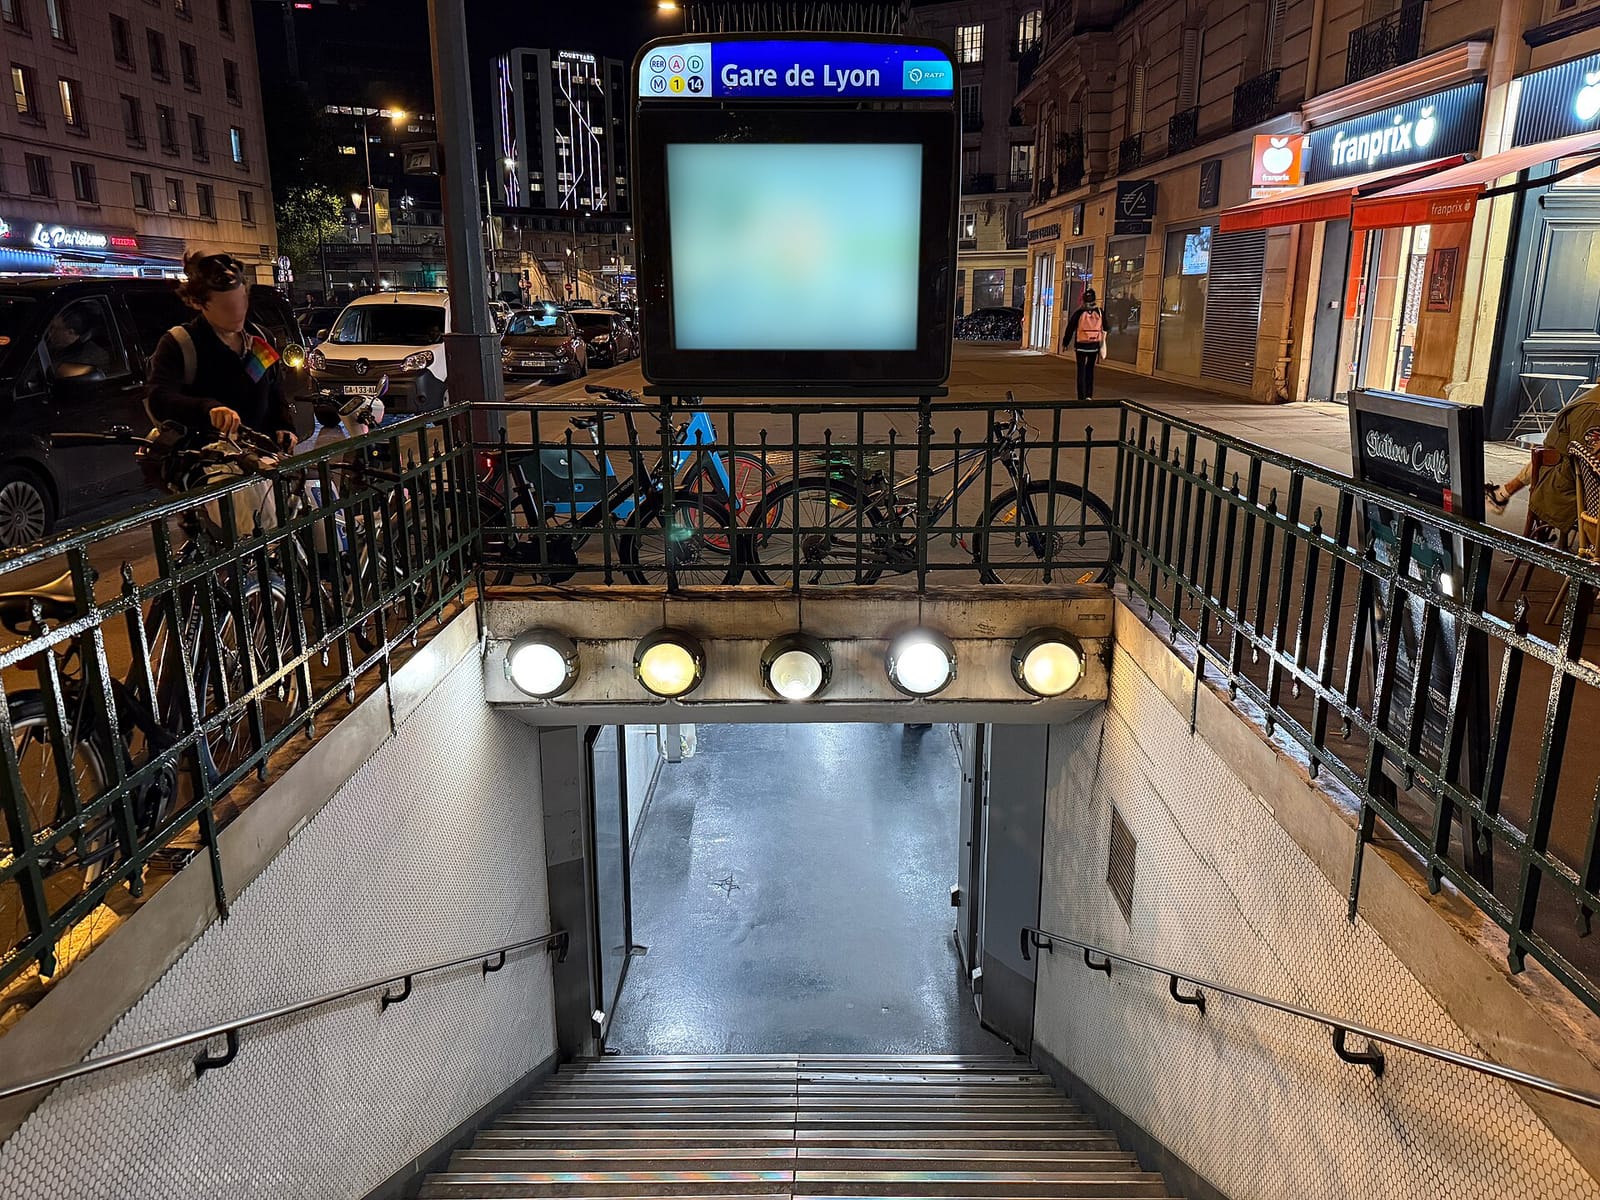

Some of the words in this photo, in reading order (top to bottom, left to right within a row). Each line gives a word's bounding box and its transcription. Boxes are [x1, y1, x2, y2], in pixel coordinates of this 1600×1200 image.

[559, 51, 595, 61] COURTYARD
[651, 60, 665, 68] RER
[673, 60, 681, 69] A
[692, 60, 700, 69] D
[673, 79, 679, 90] 1
[688, 79, 702, 90] 14
[720, 64, 778, 88] Gare
[785, 64, 815, 87] de
[823, 64, 880, 92] Lyon
[1332, 114, 1413, 166] franprix
[1261, 174, 1290, 182] franprix
[1431, 200, 1464, 217] franprix
[1366, 429, 1410, 465] Station
[1411, 441, 1450, 484] Café
